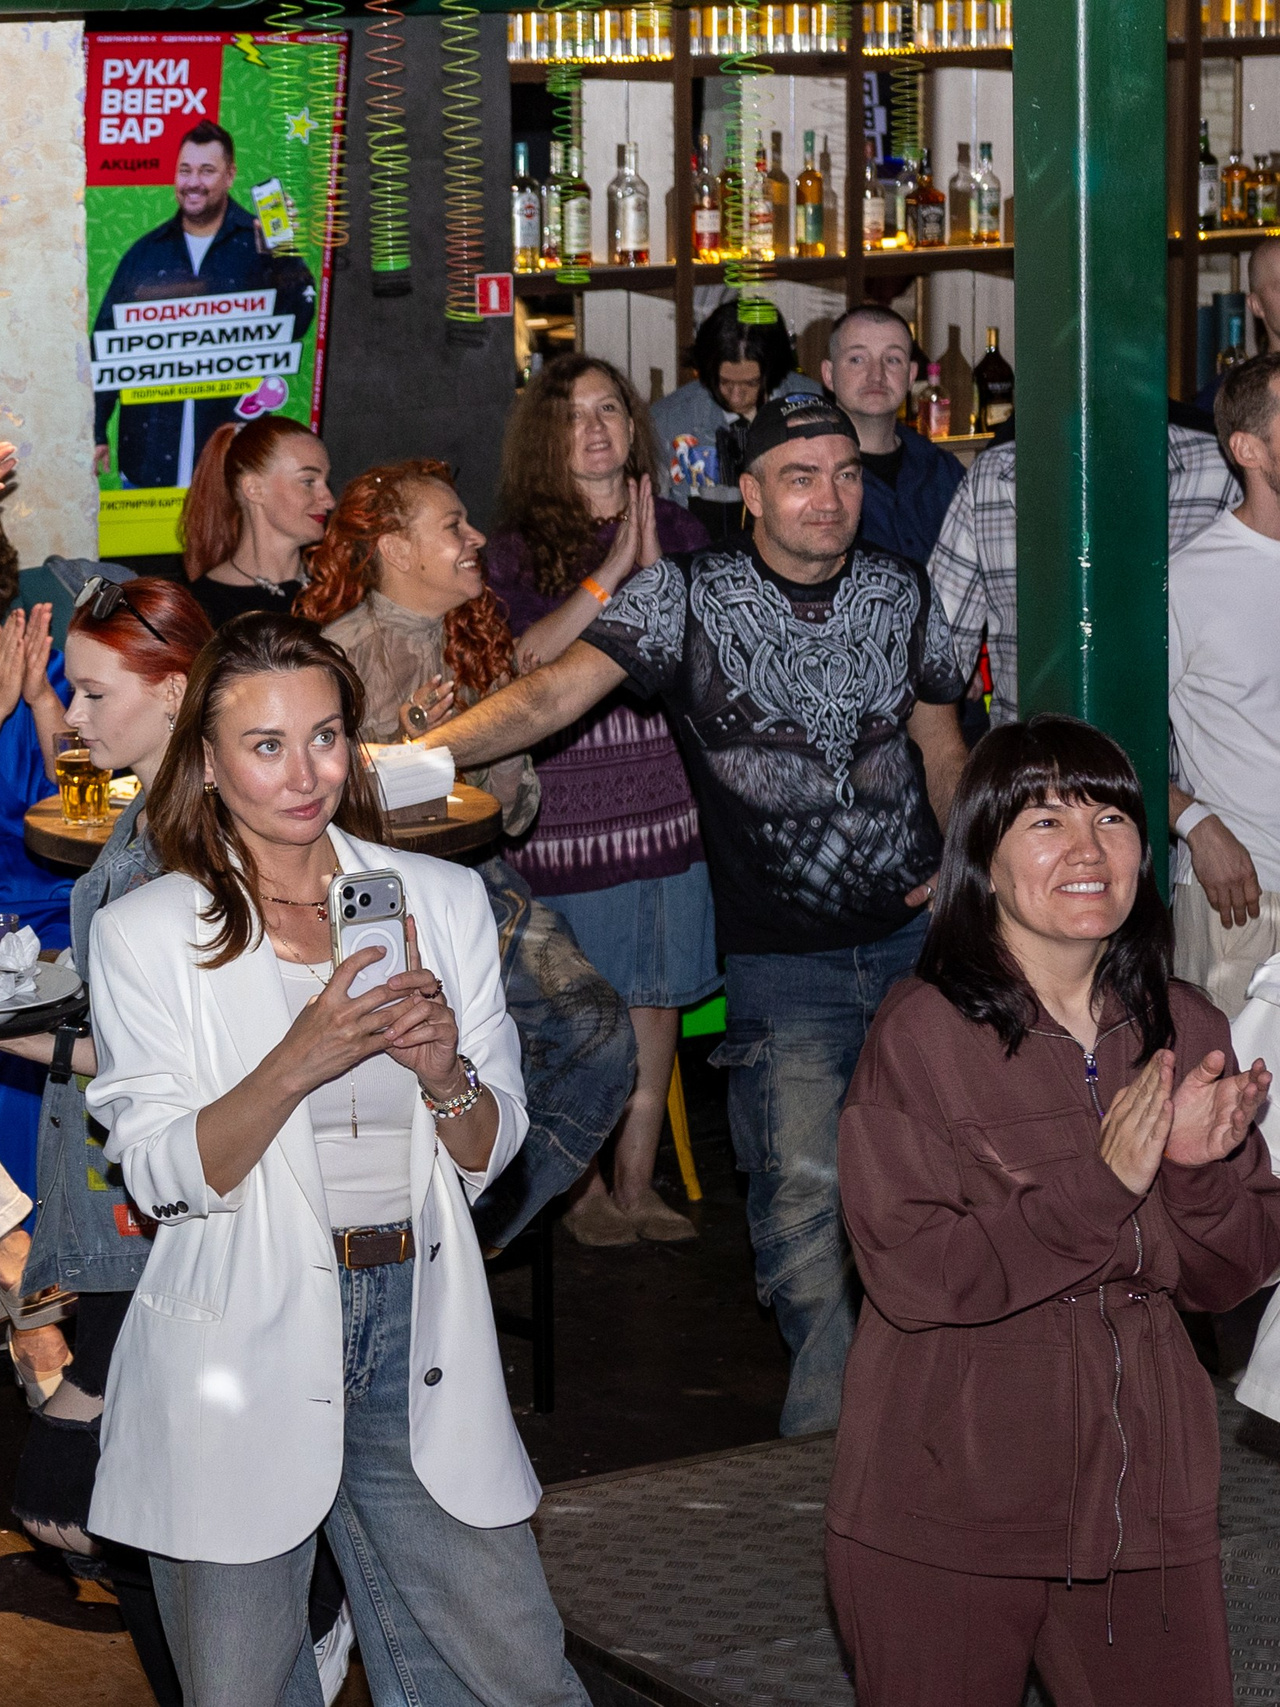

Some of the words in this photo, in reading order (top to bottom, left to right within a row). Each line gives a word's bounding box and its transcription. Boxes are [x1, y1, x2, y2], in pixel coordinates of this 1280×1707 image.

[103, 58, 189, 85] РУКИ
[101, 87, 207, 115] ВВЕРХ
[99, 117, 164, 144] БАР
[100, 158, 160, 171] АКЦИЯ
[125, 297, 266, 323] ПОДКЛЮЧИ
[107, 323, 283, 354] ПРОГРАММУ
[97, 352, 291, 385] ЛОЯЛЬНОСТИ
